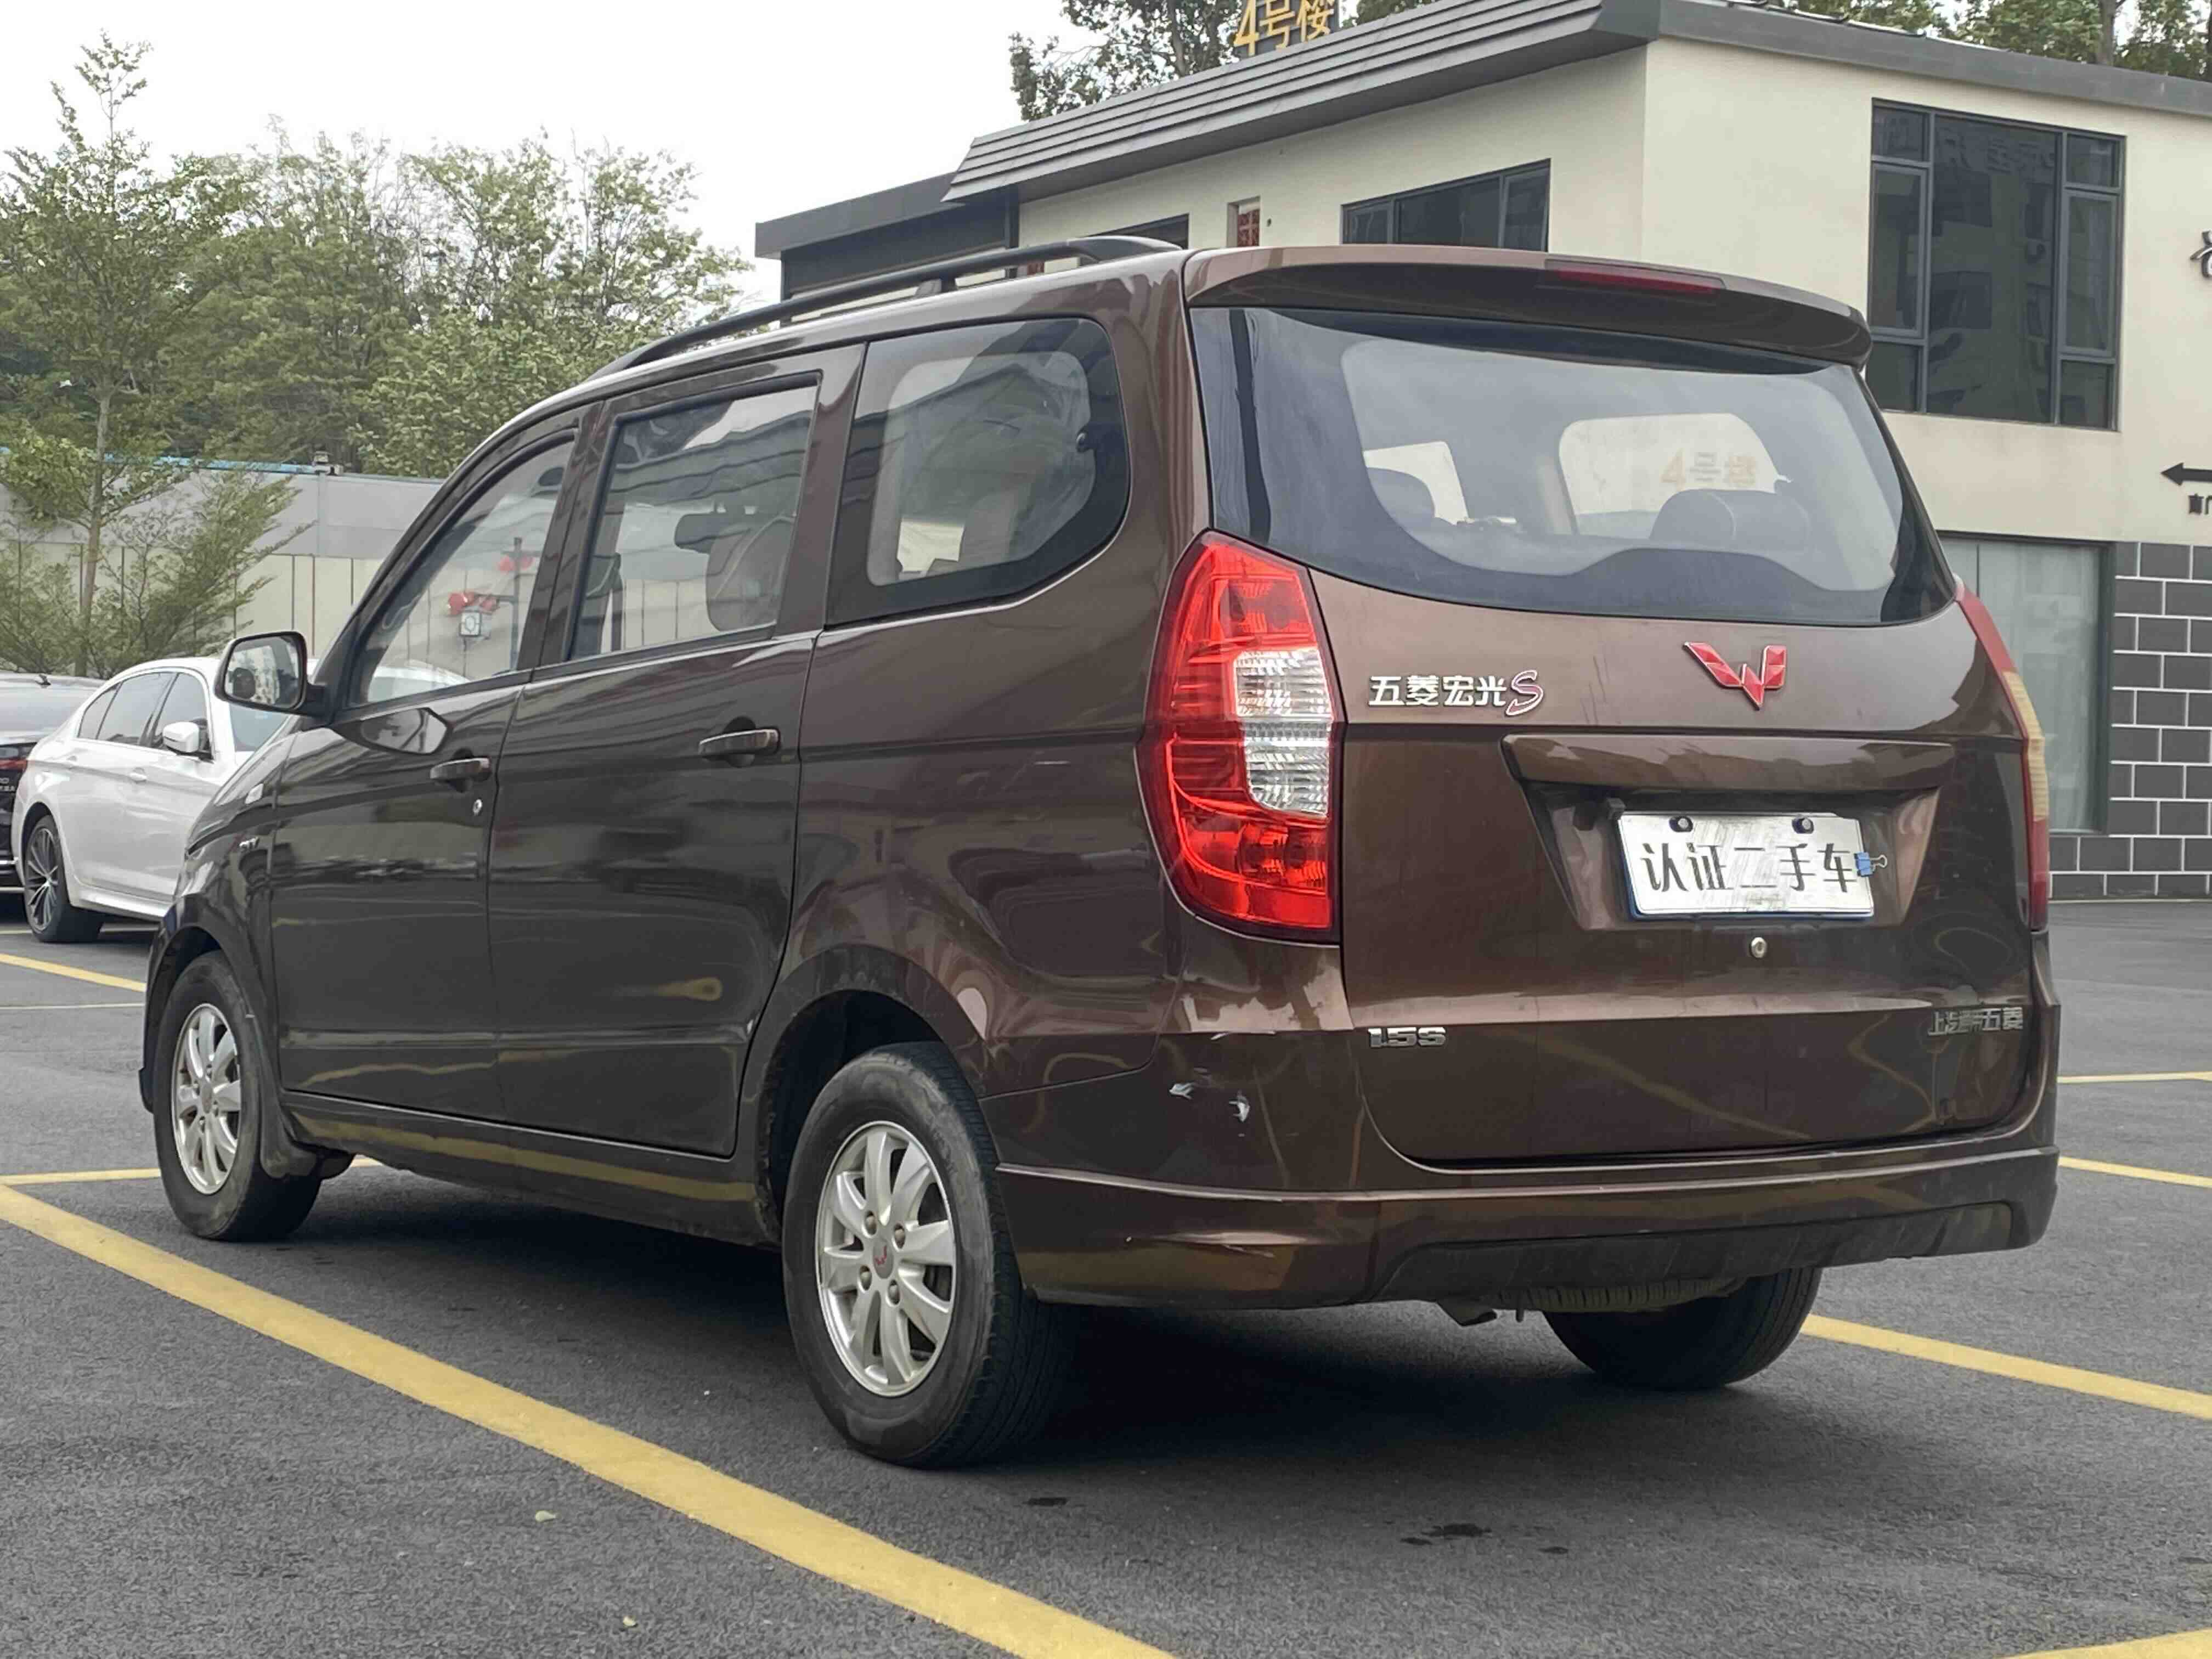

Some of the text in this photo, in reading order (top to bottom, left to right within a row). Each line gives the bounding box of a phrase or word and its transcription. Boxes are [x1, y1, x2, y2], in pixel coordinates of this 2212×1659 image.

[1234, 0, 1335, 55] 4号楼
[1640, 843, 1857, 893] 认证二手车
